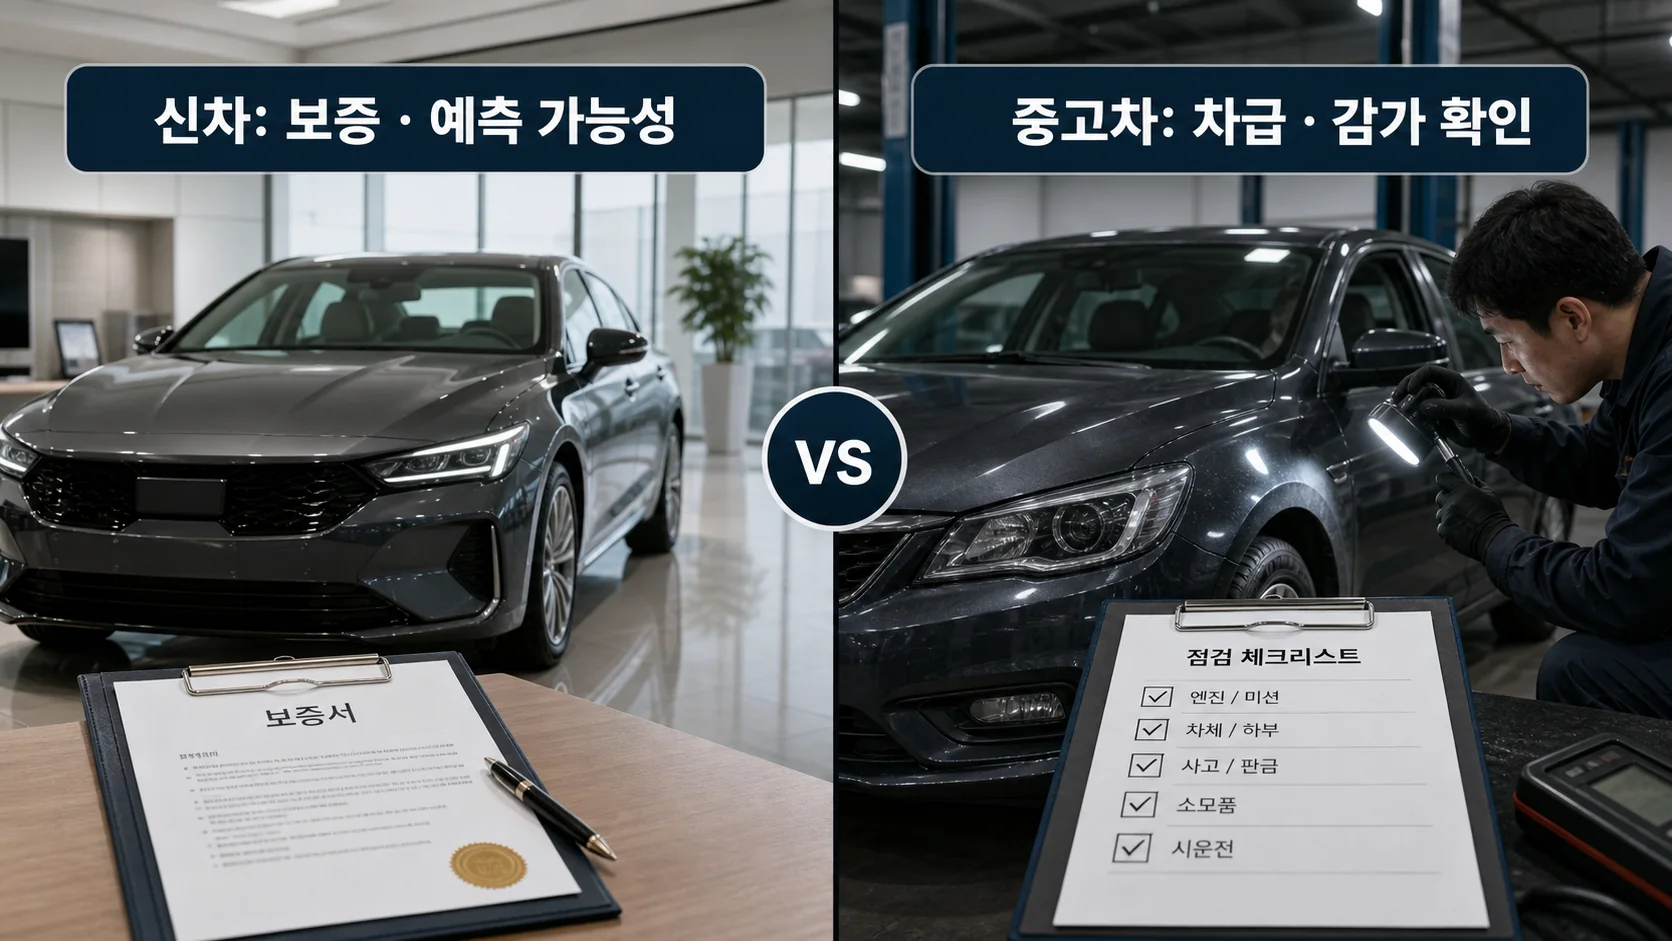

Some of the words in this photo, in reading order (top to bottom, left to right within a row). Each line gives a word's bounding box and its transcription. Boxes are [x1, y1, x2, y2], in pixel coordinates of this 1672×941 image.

[1186, 647, 1232, 667] 점검
[1240, 647, 1362, 667] 체크리스트
[1190, 690, 1225, 705] 엔진
[1245, 690, 1279, 705] 미션
[265, 702, 357, 728] 보증서
[1185, 722, 1223, 738] 차체
[1242, 722, 1280, 738] 하부
[1181, 758, 1220, 775] 사고
[1240, 758, 1279, 775] 판금
[1176, 797, 1237, 814] 소모품
[1171, 839, 1234, 859] 시운전
